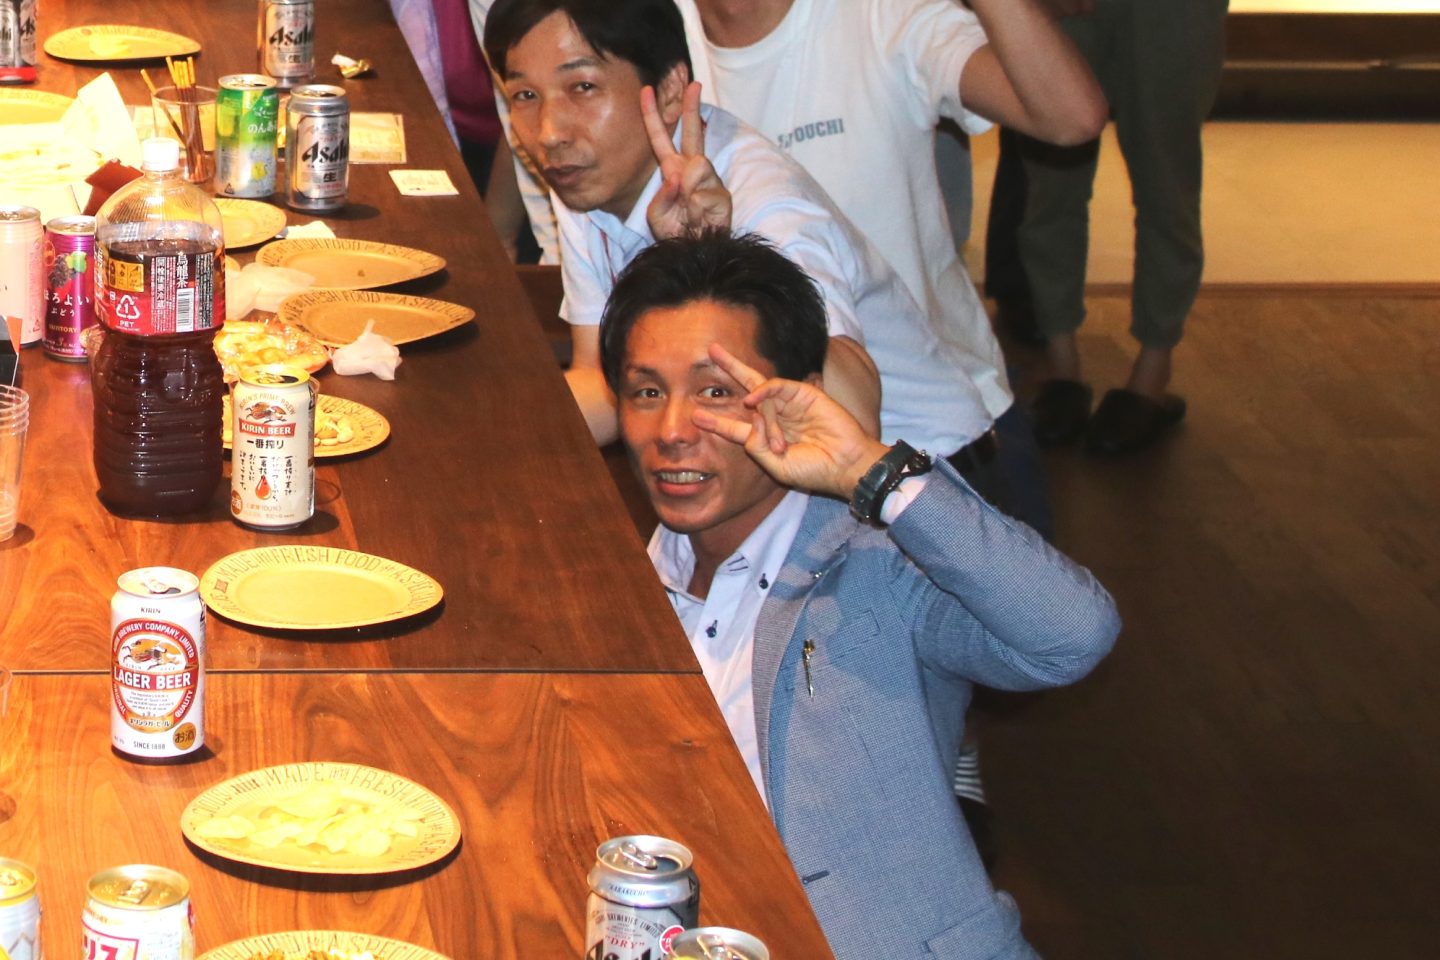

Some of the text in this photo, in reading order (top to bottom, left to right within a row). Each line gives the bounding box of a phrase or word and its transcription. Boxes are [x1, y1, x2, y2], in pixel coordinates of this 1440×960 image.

[269, 25, 313, 46] Asah
[302, 139, 349, 162] Asah
[241, 422, 291, 435] KIRIN BEER
[246, 439, 285, 450] 一番搾り
[335, 551, 381, 571] FOOD
[118, 622, 195, 658] BREWERY COMPANY, LIMITED
[114, 666, 191, 690] LAGER BEER
[174, 689, 194, 718] QUALITY
[133, 741, 150, 750] SINCE
[174, 728, 195, 744] お酒
